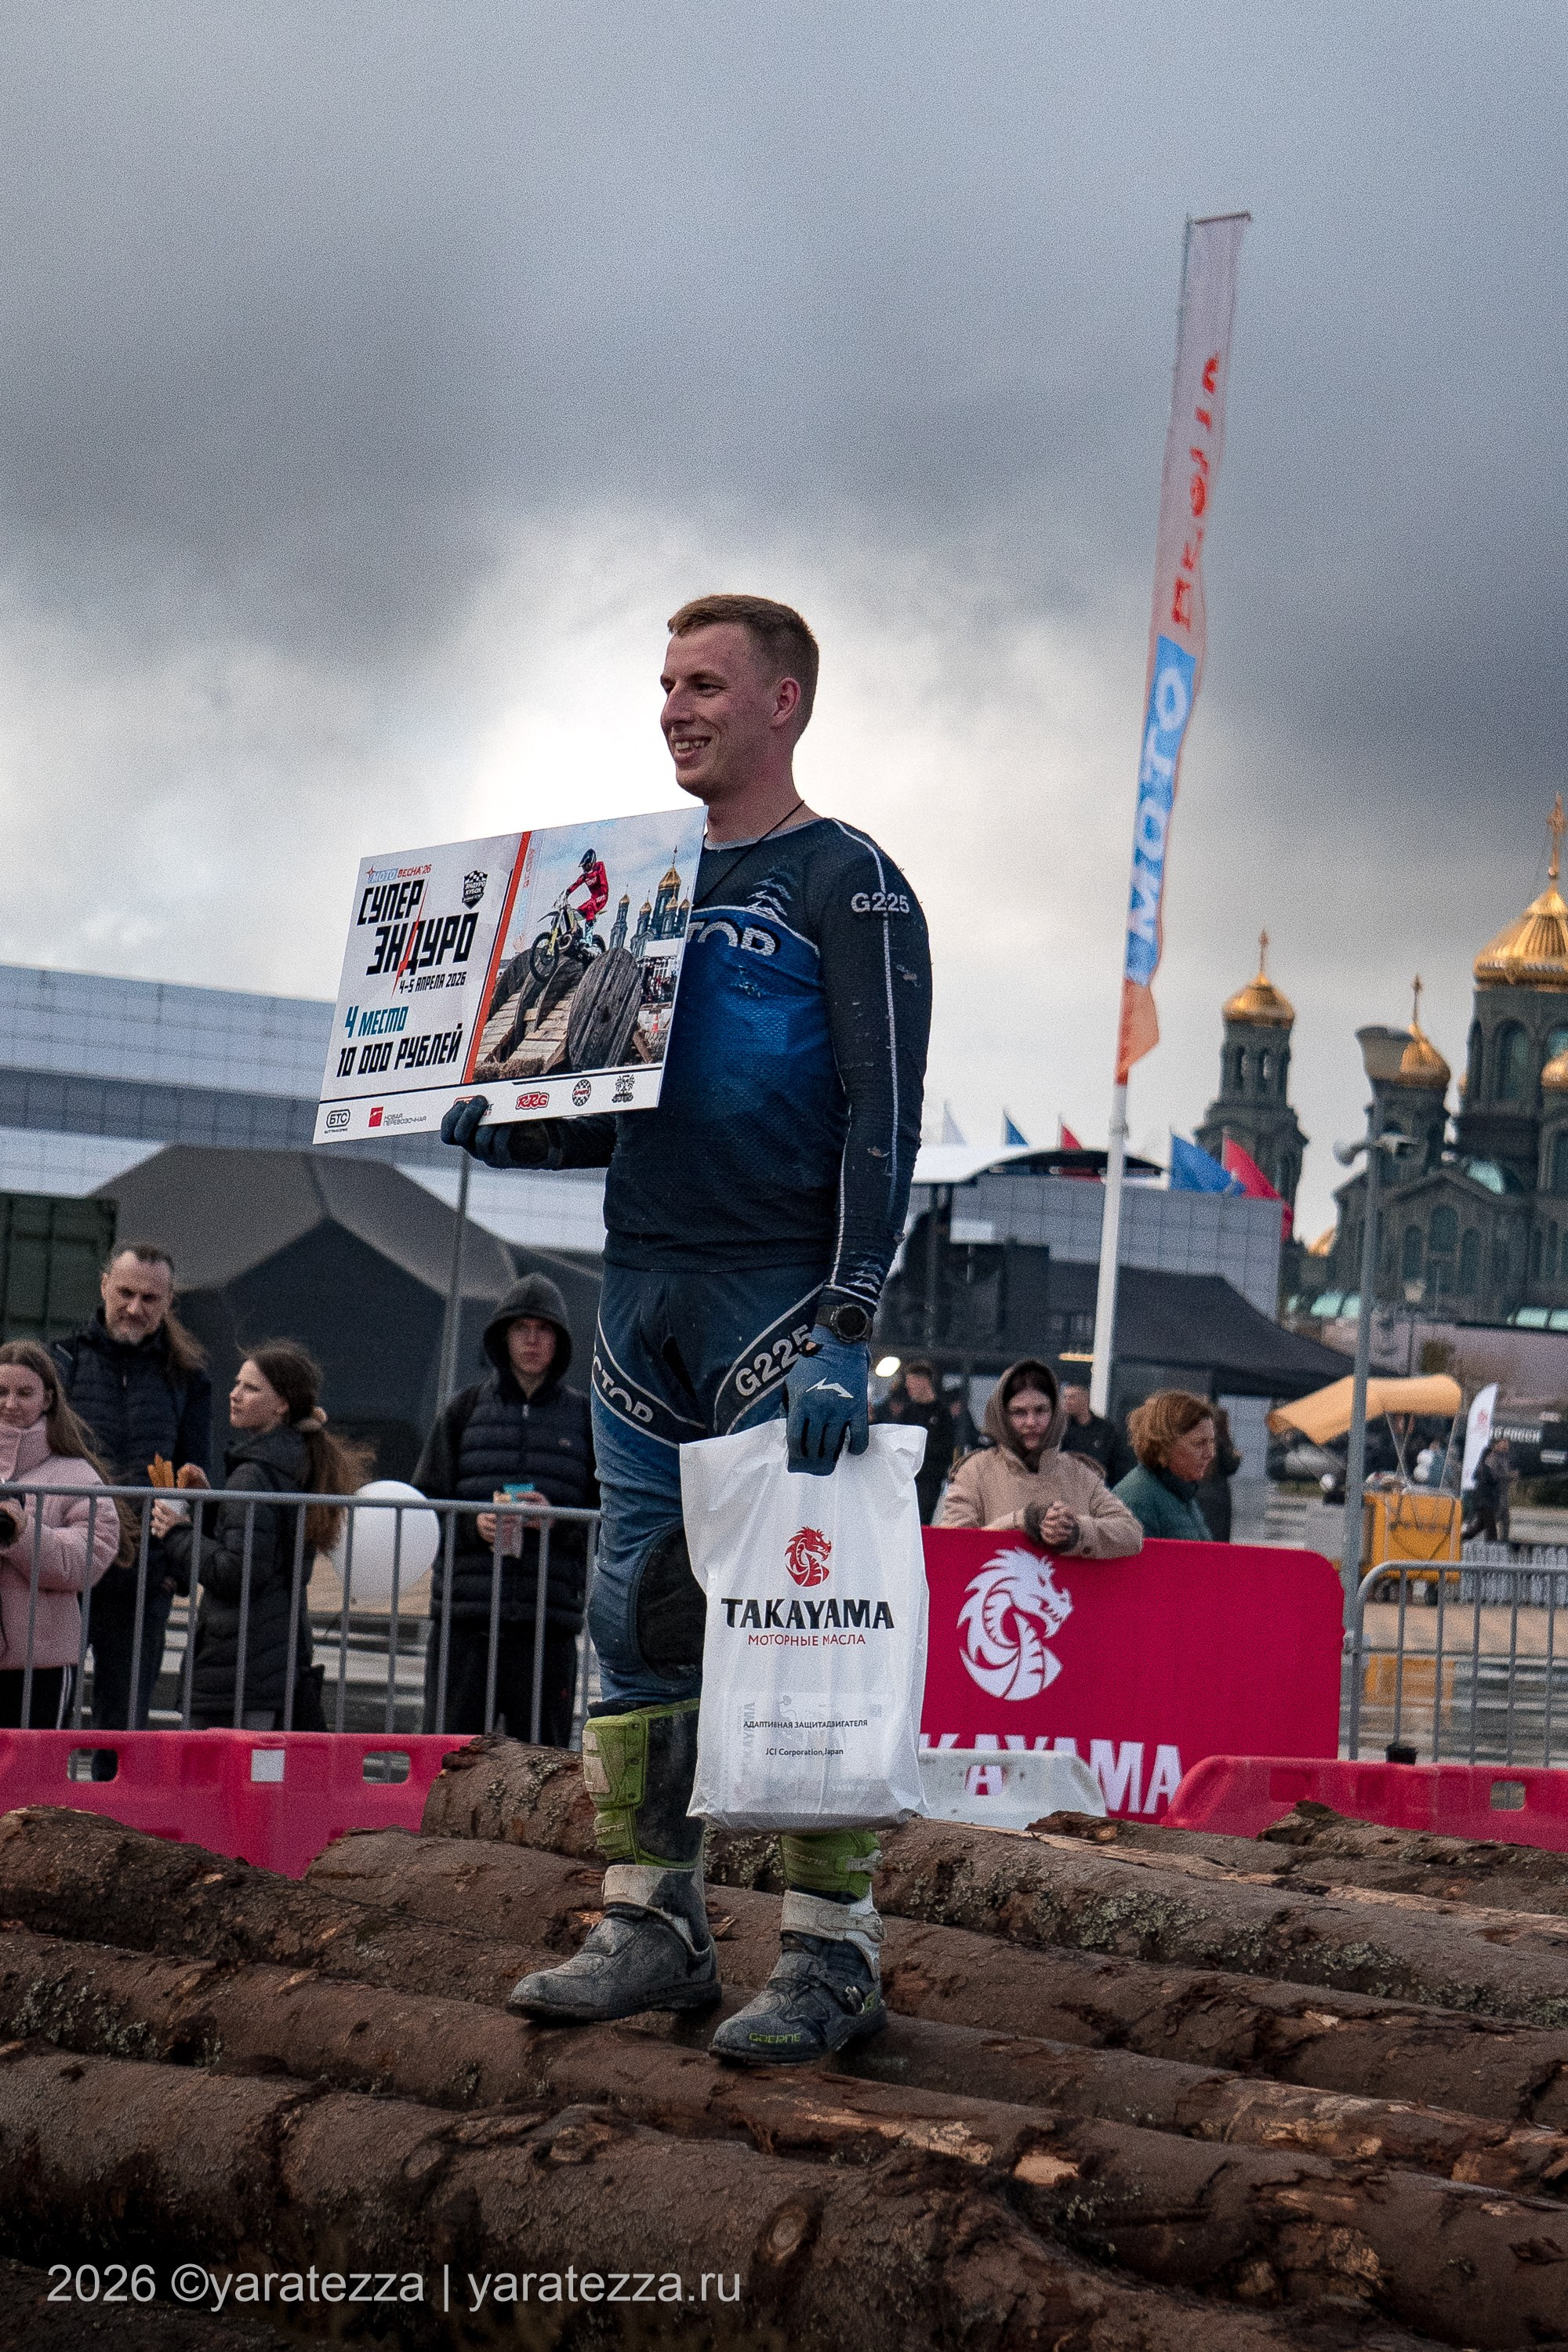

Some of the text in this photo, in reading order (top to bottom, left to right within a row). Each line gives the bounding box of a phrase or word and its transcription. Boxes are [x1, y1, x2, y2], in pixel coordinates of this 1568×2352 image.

[372, 869, 396, 881] МОТО
[357, 879, 425, 926] СУПЕР
[851, 892, 910, 913] G225
[366, 912, 480, 977] ЭНДУРО
[399, 971, 467, 994] 4-5 АПРЕЛЯ 2026
[344, 1005, 409, 1038] 4 МЕСТО
[336, 1022, 463, 1078] 10 000 РУБЛЕЙ
[517, 1093, 549, 1108] RRG
[328, 1113, 348, 1124] БТС
[383, 1116, 427, 1126] ПЕРЕВОЗОЧНАЯ
[720, 1598, 895, 1630] TAKAYAMA
[748, 1634, 866, 1646] МОТОРНЫЕ МАСЛА
